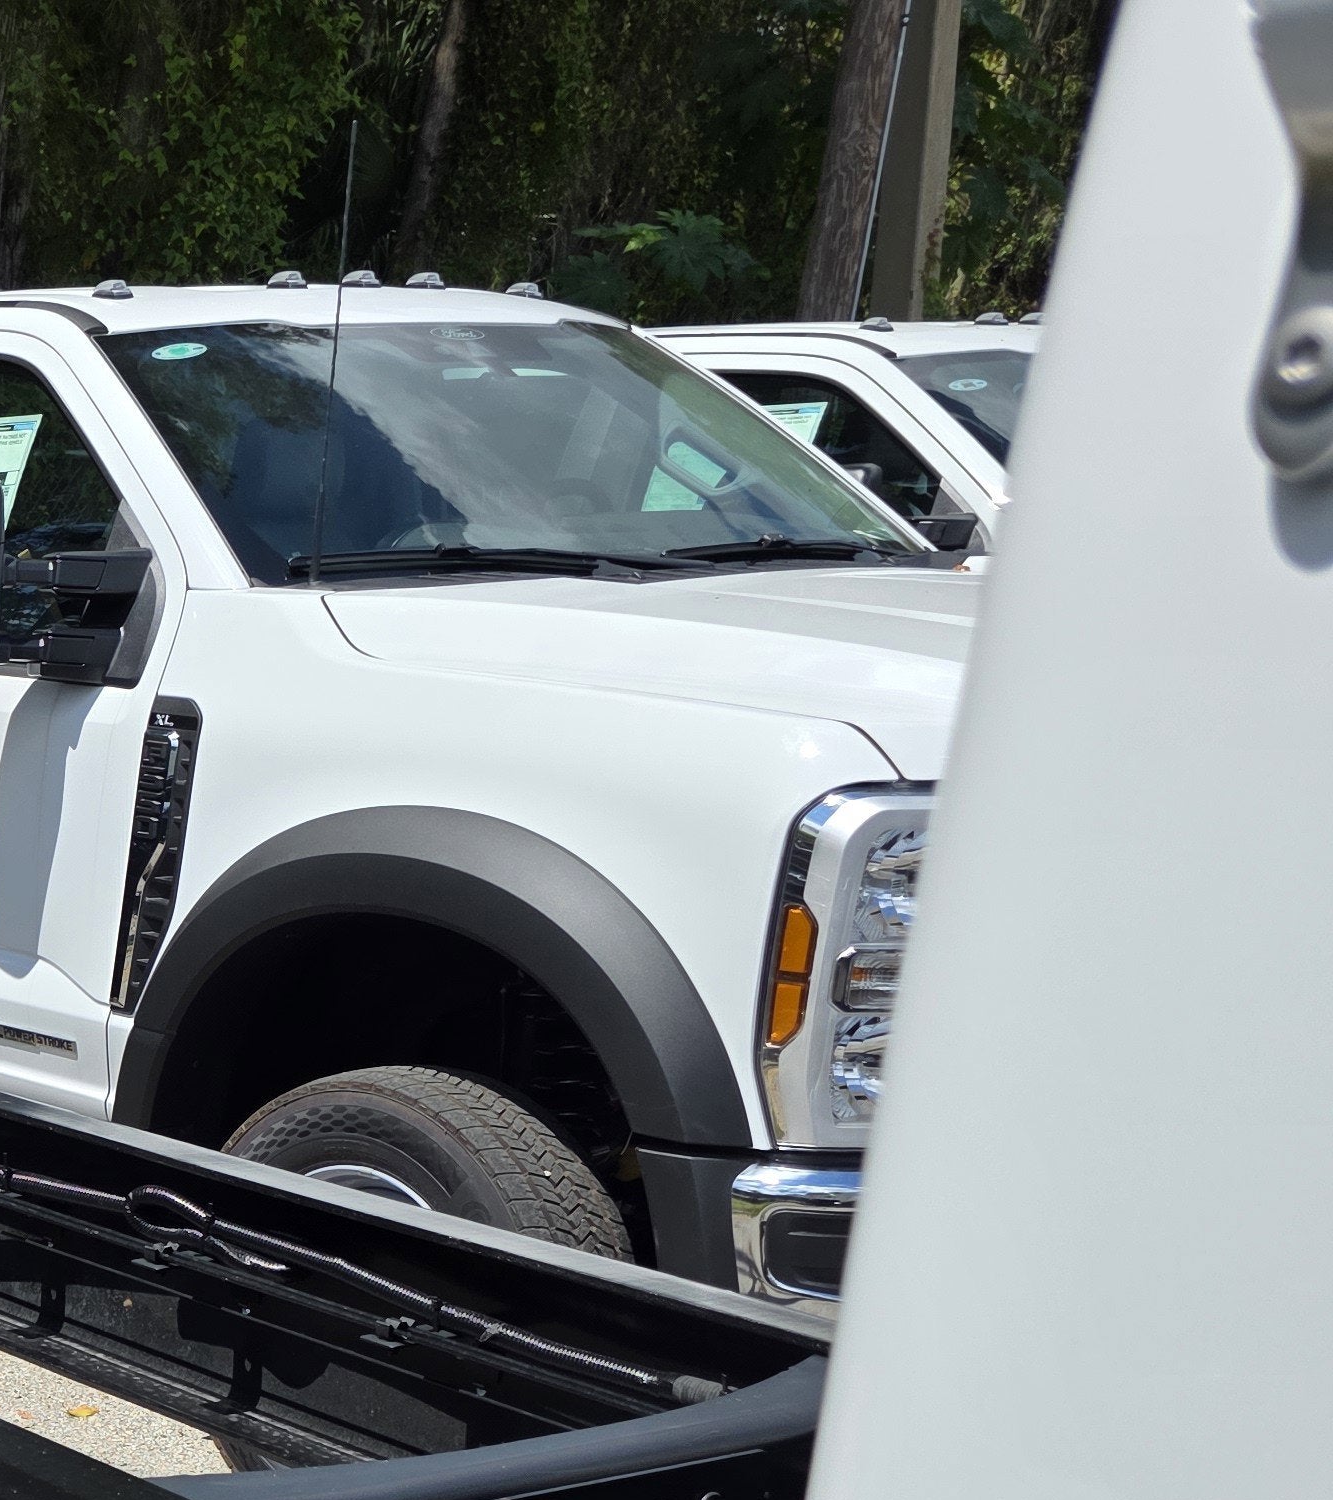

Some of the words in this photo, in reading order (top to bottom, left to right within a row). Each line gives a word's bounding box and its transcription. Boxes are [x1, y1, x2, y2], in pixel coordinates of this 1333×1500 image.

[154, 714, 174, 726] XL
[3, 1028, 35, 1045] POWER
[36, 1034, 74, 1052] STROKE
